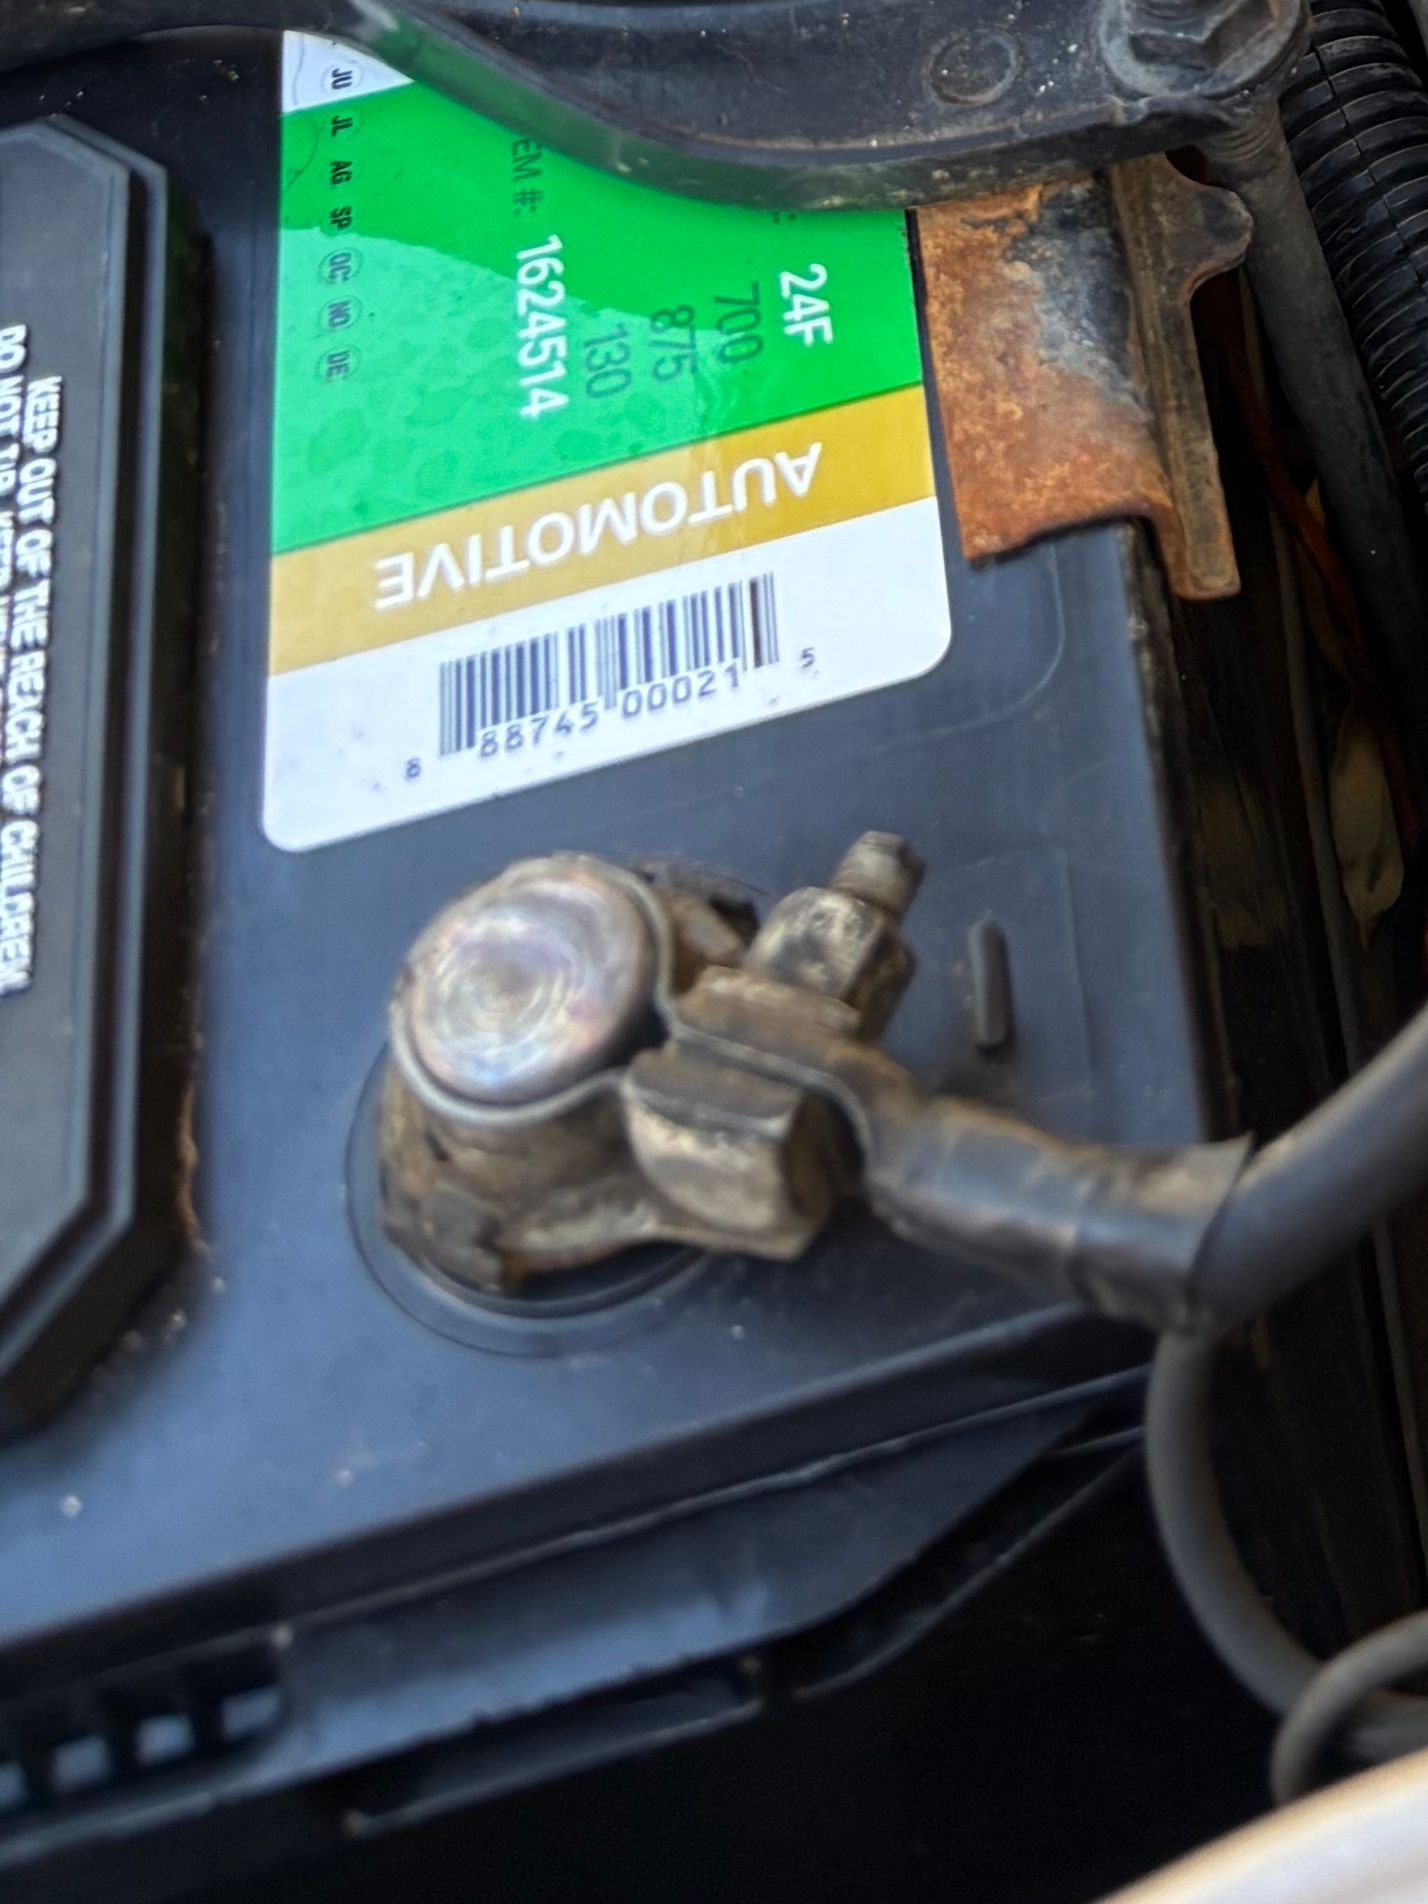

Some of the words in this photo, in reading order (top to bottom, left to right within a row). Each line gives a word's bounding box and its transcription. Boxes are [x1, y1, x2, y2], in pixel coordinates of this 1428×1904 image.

[331, 68, 353, 90] JU
[330, 114, 353, 137] JL
[329, 160, 353, 185] AG
[329, 205, 353, 230] SP
[327, 251, 351, 282] OC
[327, 299, 351, 327] NO
[515, 233, 569, 419] 1624514
[713, 280, 764, 364] 700
[778, 262, 834, 347] 24F
[325, 348, 350, 380] DE
[584, 323, 632, 399] 130
[649, 304, 697, 382] 875
[22, 375, 62, 454] KEEP
[16, 457, 57, 525] OUT
[15, 528, 54, 579] OF
[374, 441, 823, 612] AUTOMOTIVE
[10, 577, 50, 650] THE
[4, 649, 46, 763] REACH
[405, 757, 422, 781] 8
[479, 699, 600, 760] 88745
[620, 660, 743, 719] 00021
[799, 647, 816, 669] 5
[0, 764, 41, 817] OF
